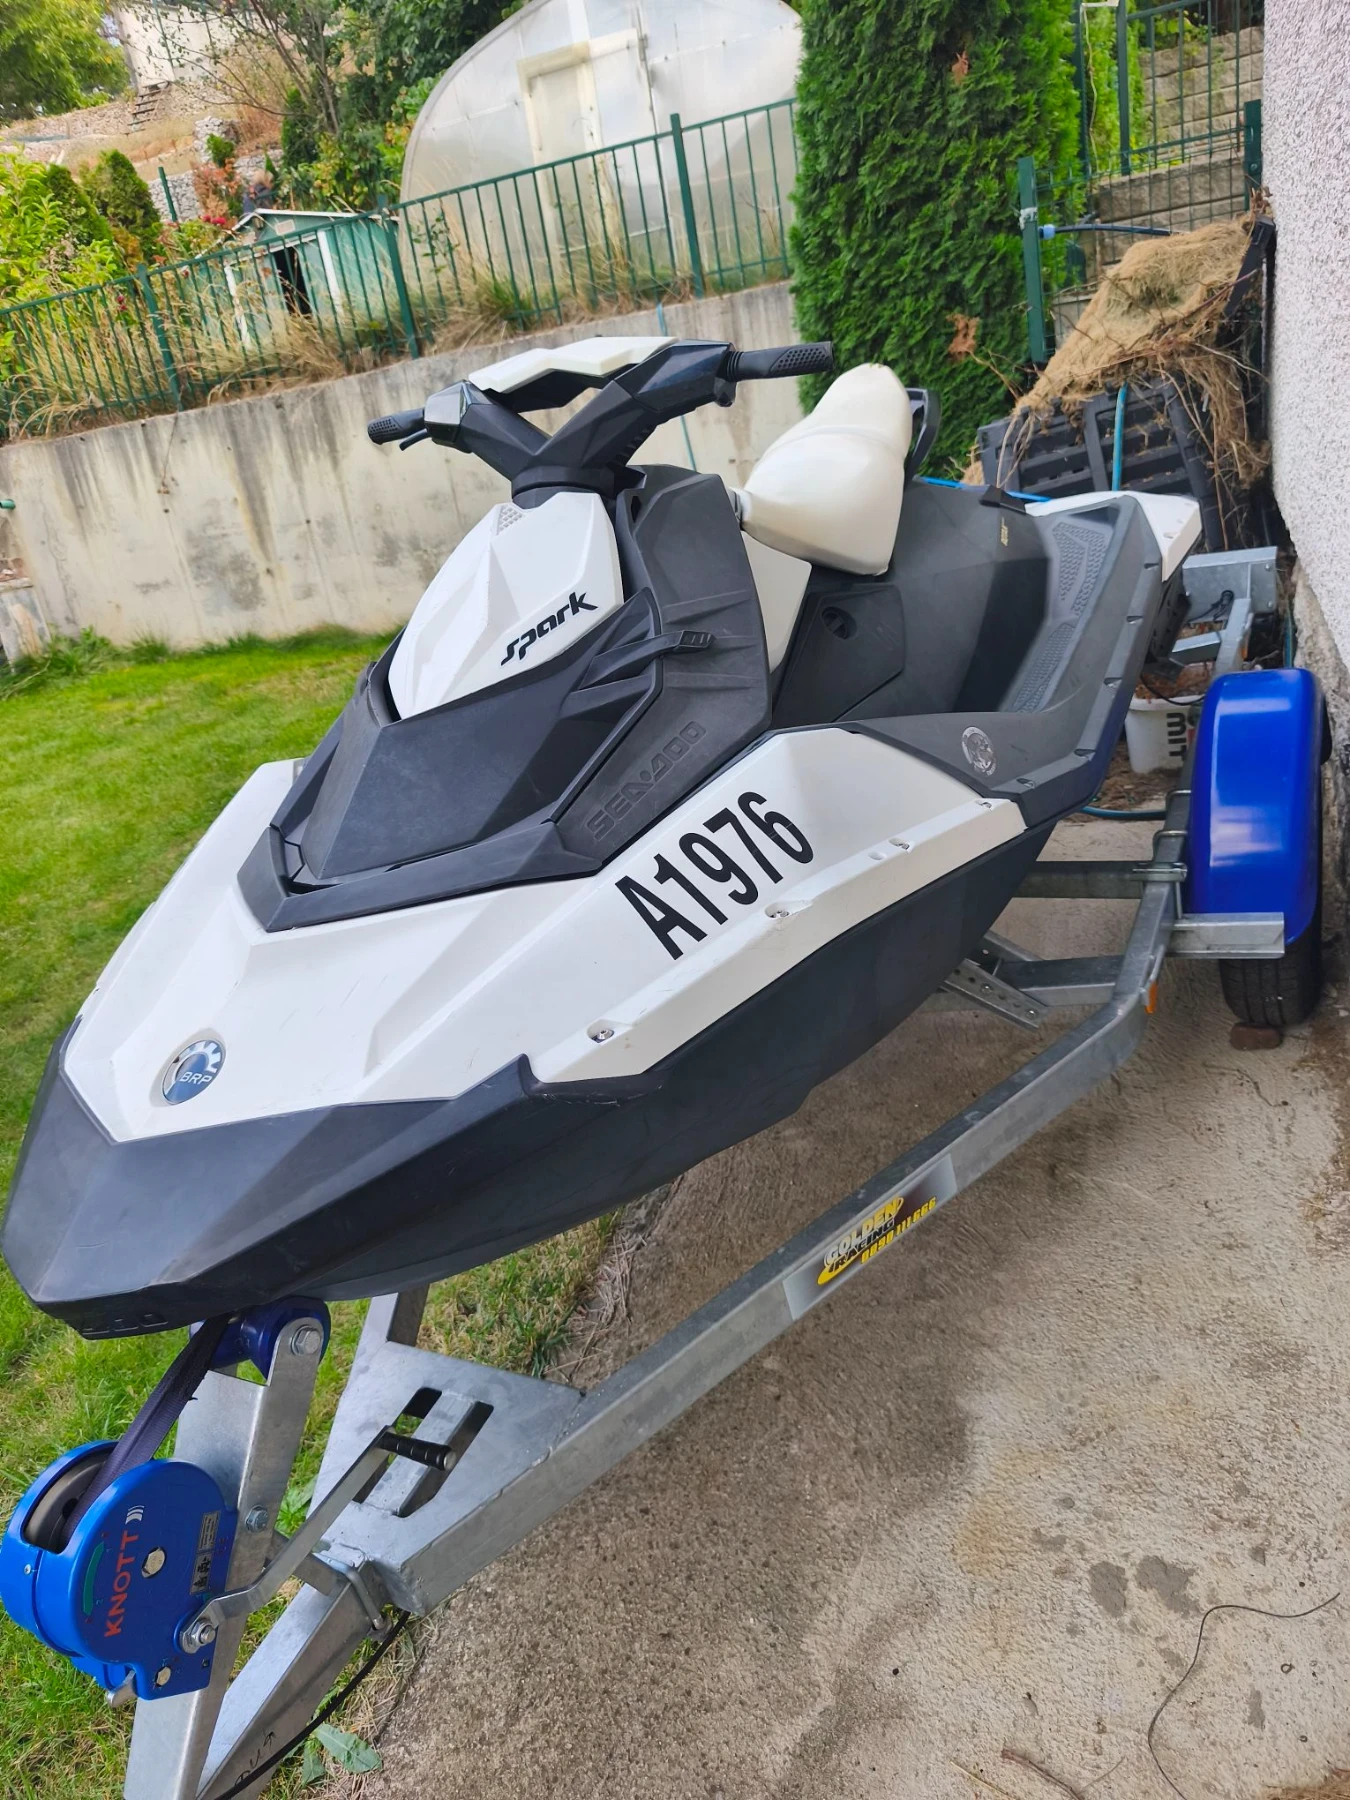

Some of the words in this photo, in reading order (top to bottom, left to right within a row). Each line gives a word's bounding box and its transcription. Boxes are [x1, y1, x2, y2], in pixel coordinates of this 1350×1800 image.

[614, 791, 814, 960] A1976
[179, 1071, 213, 1085] BRP
[826, 1199, 899, 1264] GOLDEN
[832, 1216, 895, 1271] RACING
[104, 1530, 139, 1637] KNOTT
